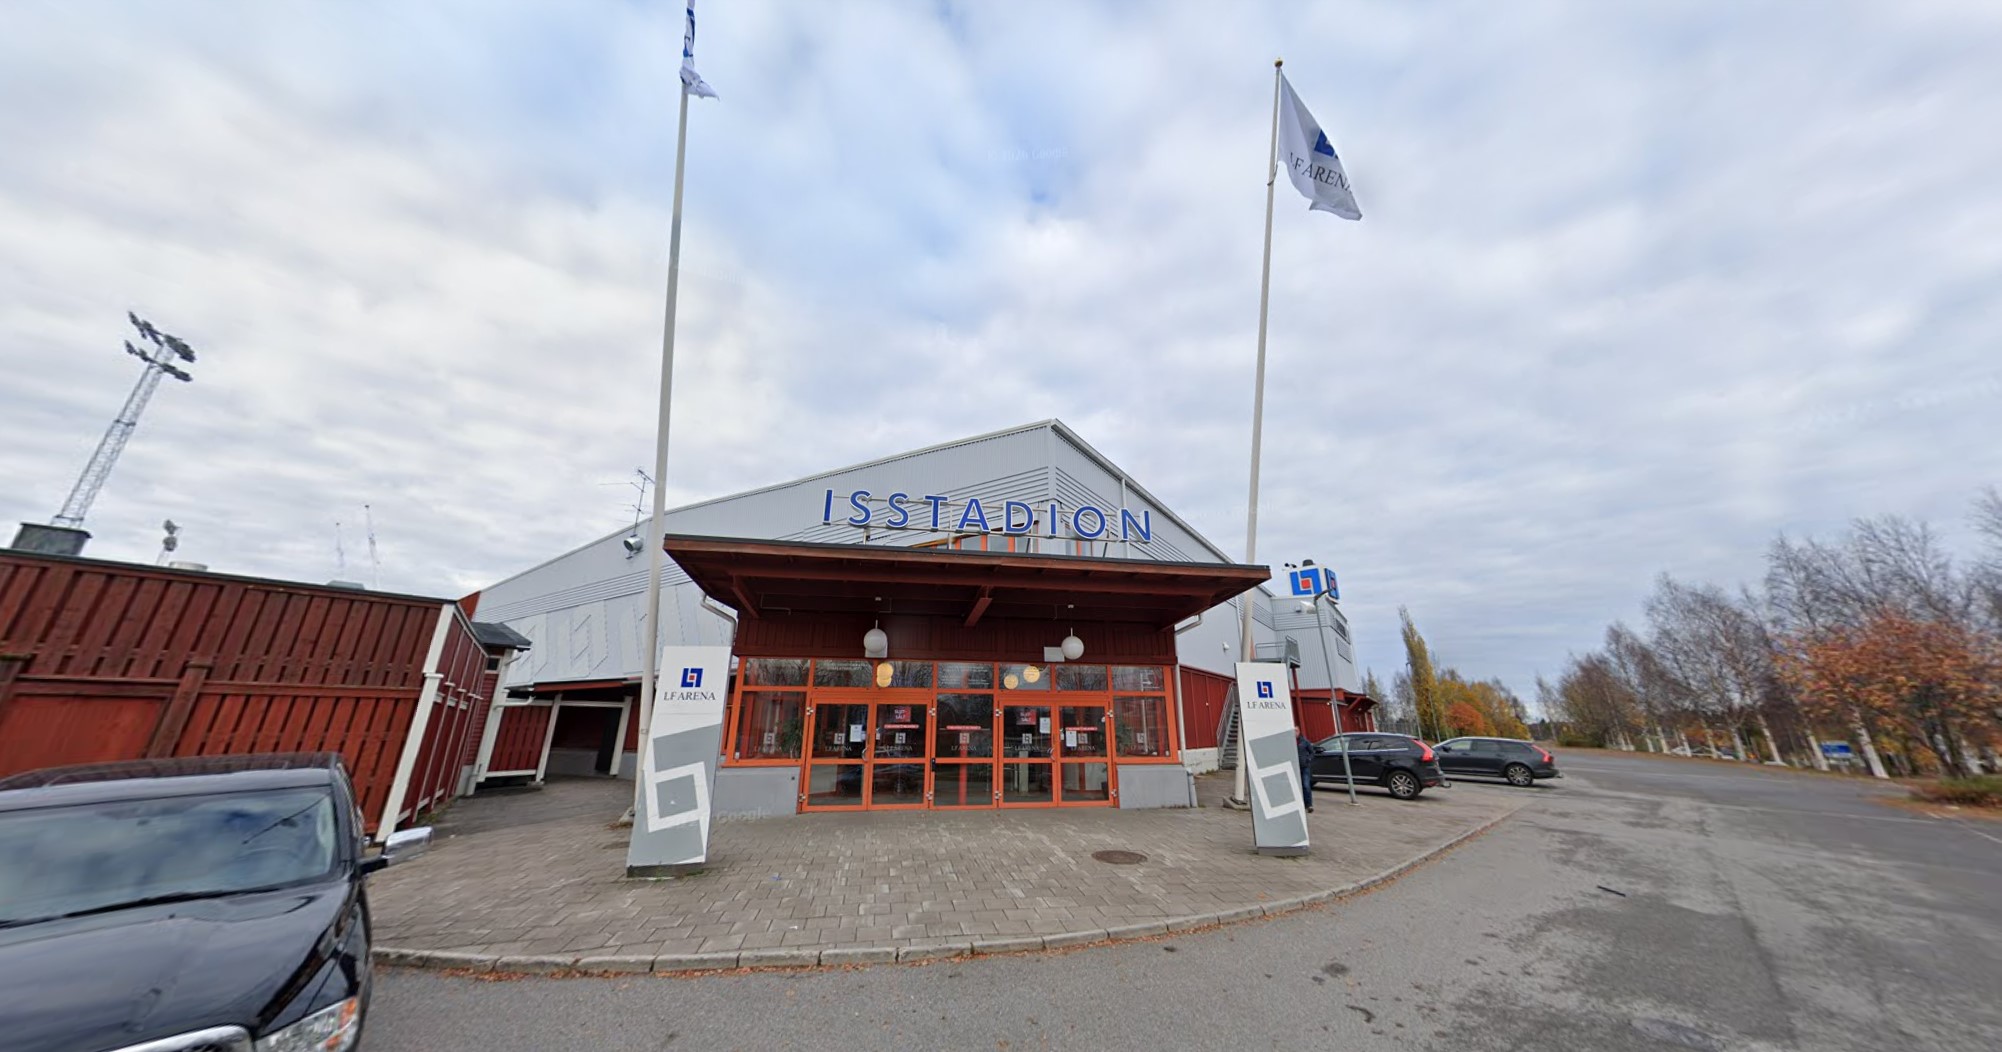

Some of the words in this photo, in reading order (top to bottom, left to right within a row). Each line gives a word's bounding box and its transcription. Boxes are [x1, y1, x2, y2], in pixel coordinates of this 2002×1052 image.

[823, 489, 1151, 543] ISSTADION
[663, 691, 677, 701] LF
[678, 691, 716, 701] ARENA
[1247, 701, 1258, 710] LF
[1259, 701, 1287, 710] ARENA
